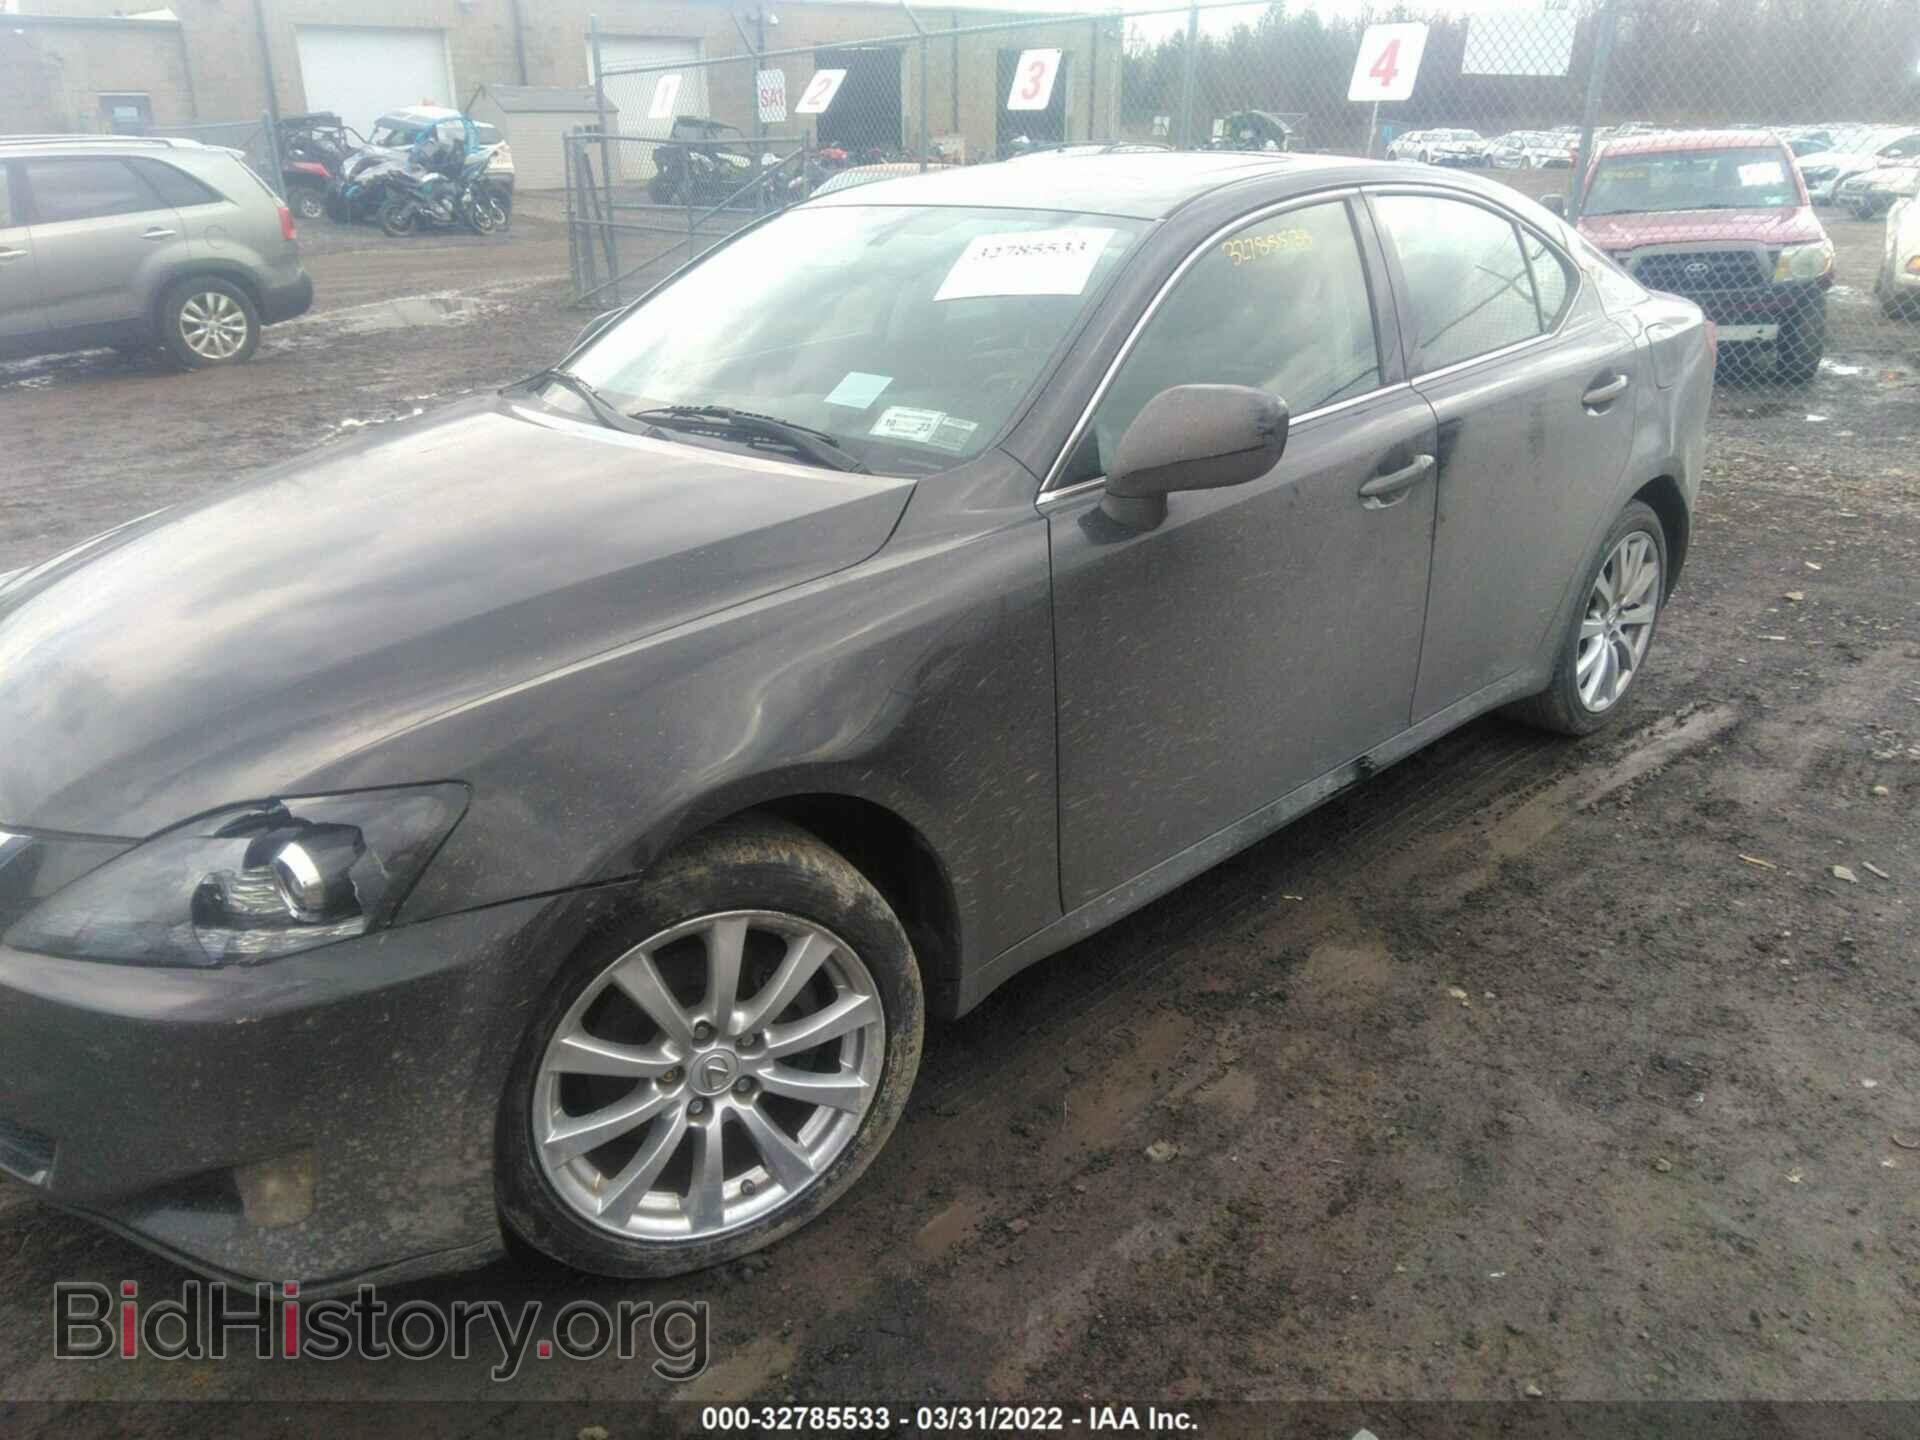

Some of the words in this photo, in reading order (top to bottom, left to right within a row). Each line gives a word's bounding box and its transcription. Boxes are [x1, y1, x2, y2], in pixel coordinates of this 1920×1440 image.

[1021, 60, 1046, 100] 3
[1369, 38, 1401, 88] 4
[806, 77, 832, 105] 2
